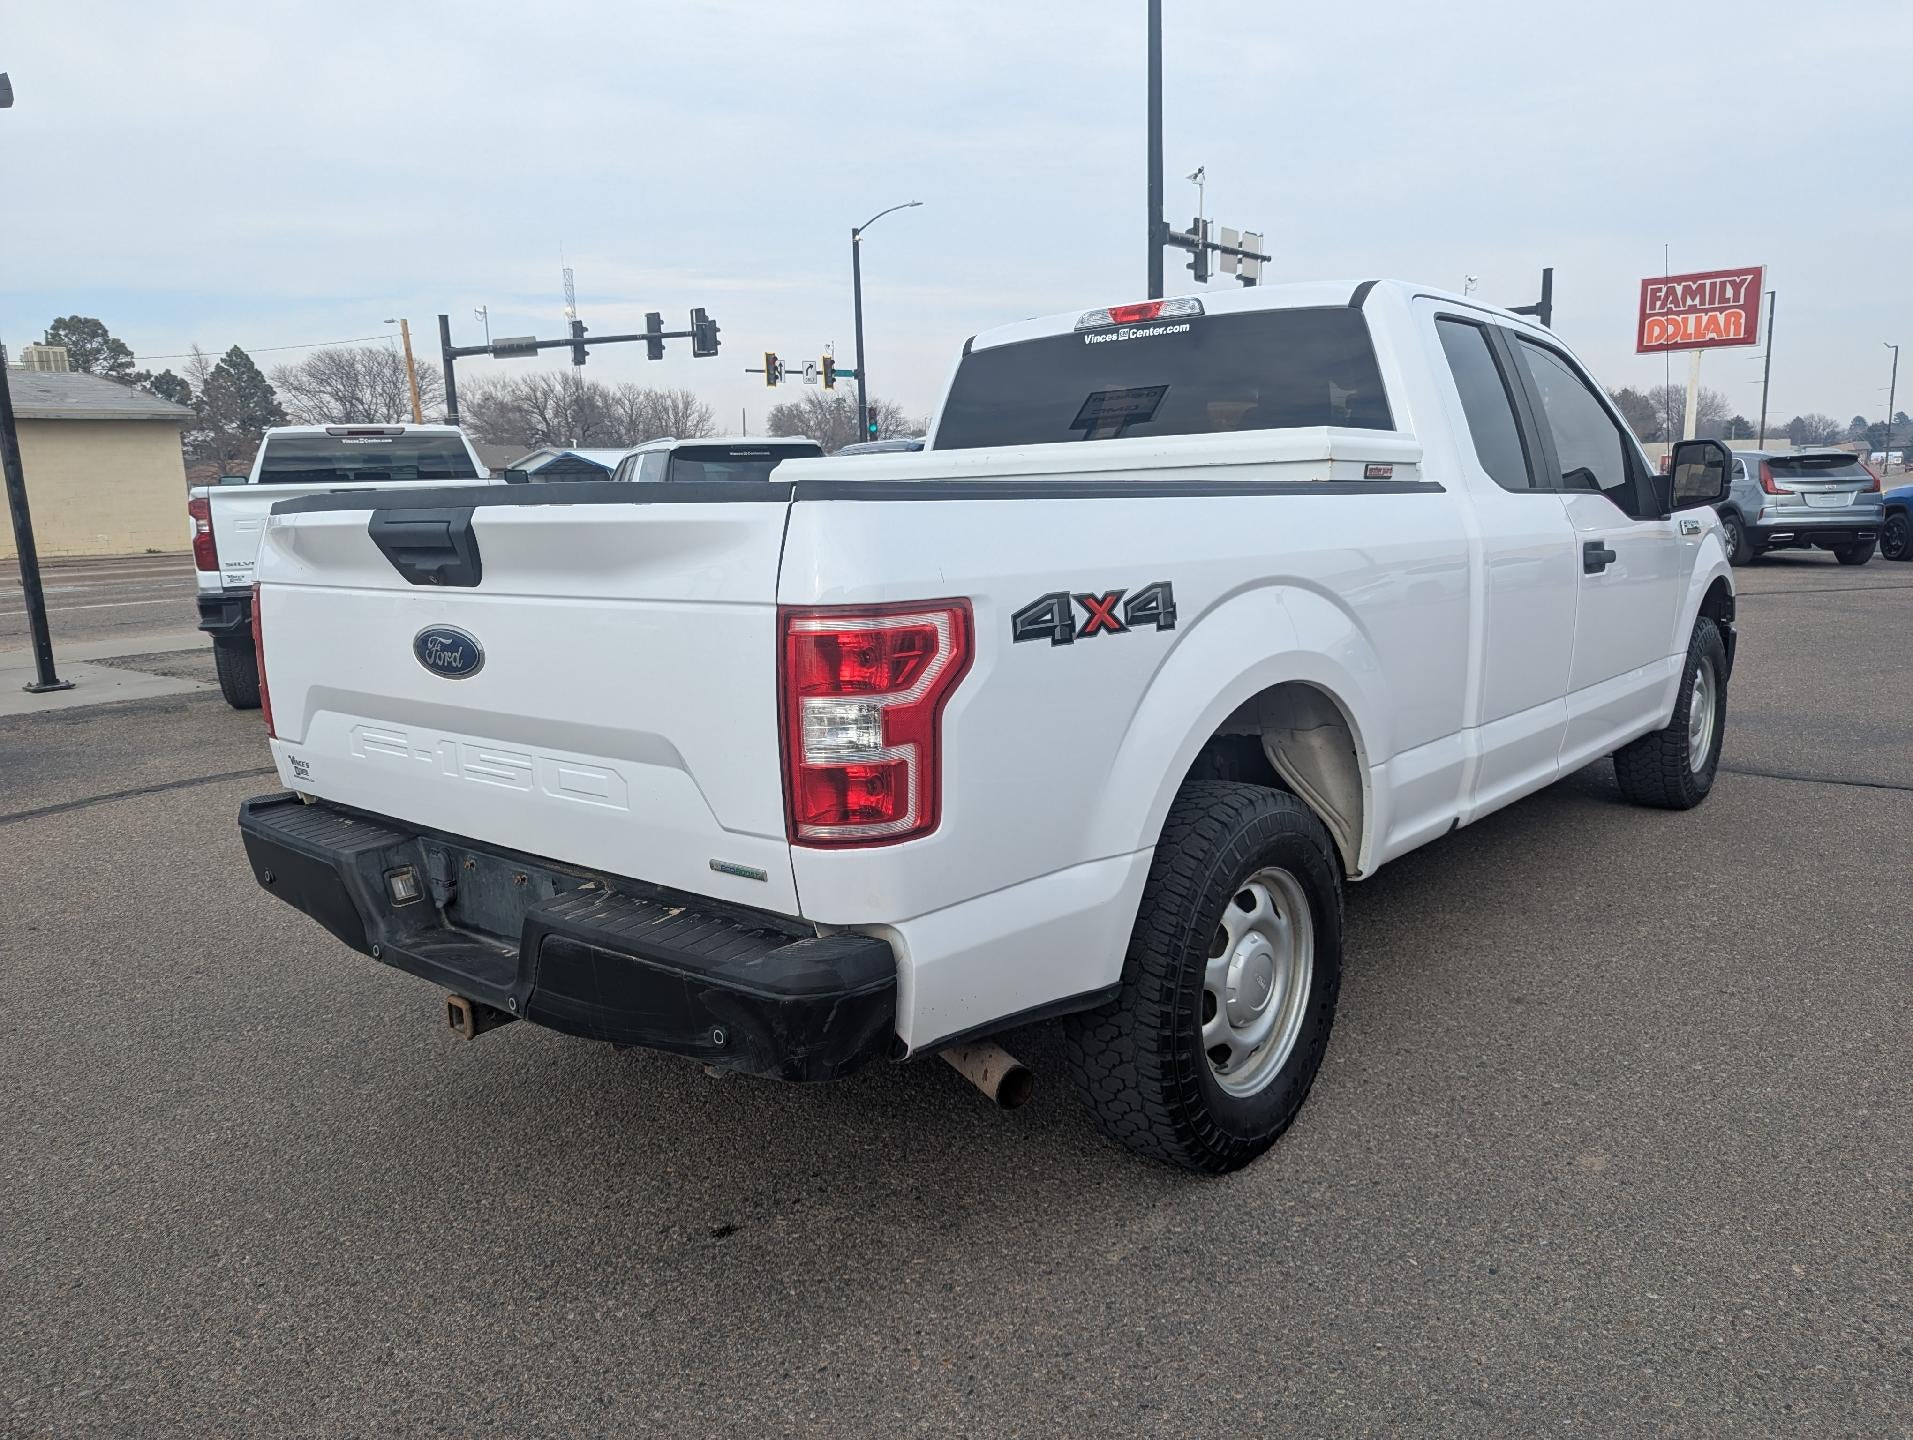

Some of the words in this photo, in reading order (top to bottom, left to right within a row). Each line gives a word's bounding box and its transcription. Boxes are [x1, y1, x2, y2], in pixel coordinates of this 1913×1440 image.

[1646, 274, 1754, 314] FAMILY
[1643, 308, 1746, 346] DOLLAR
[425, 636, 464, 668] Ford
[350, 724, 630, 811] F-150
